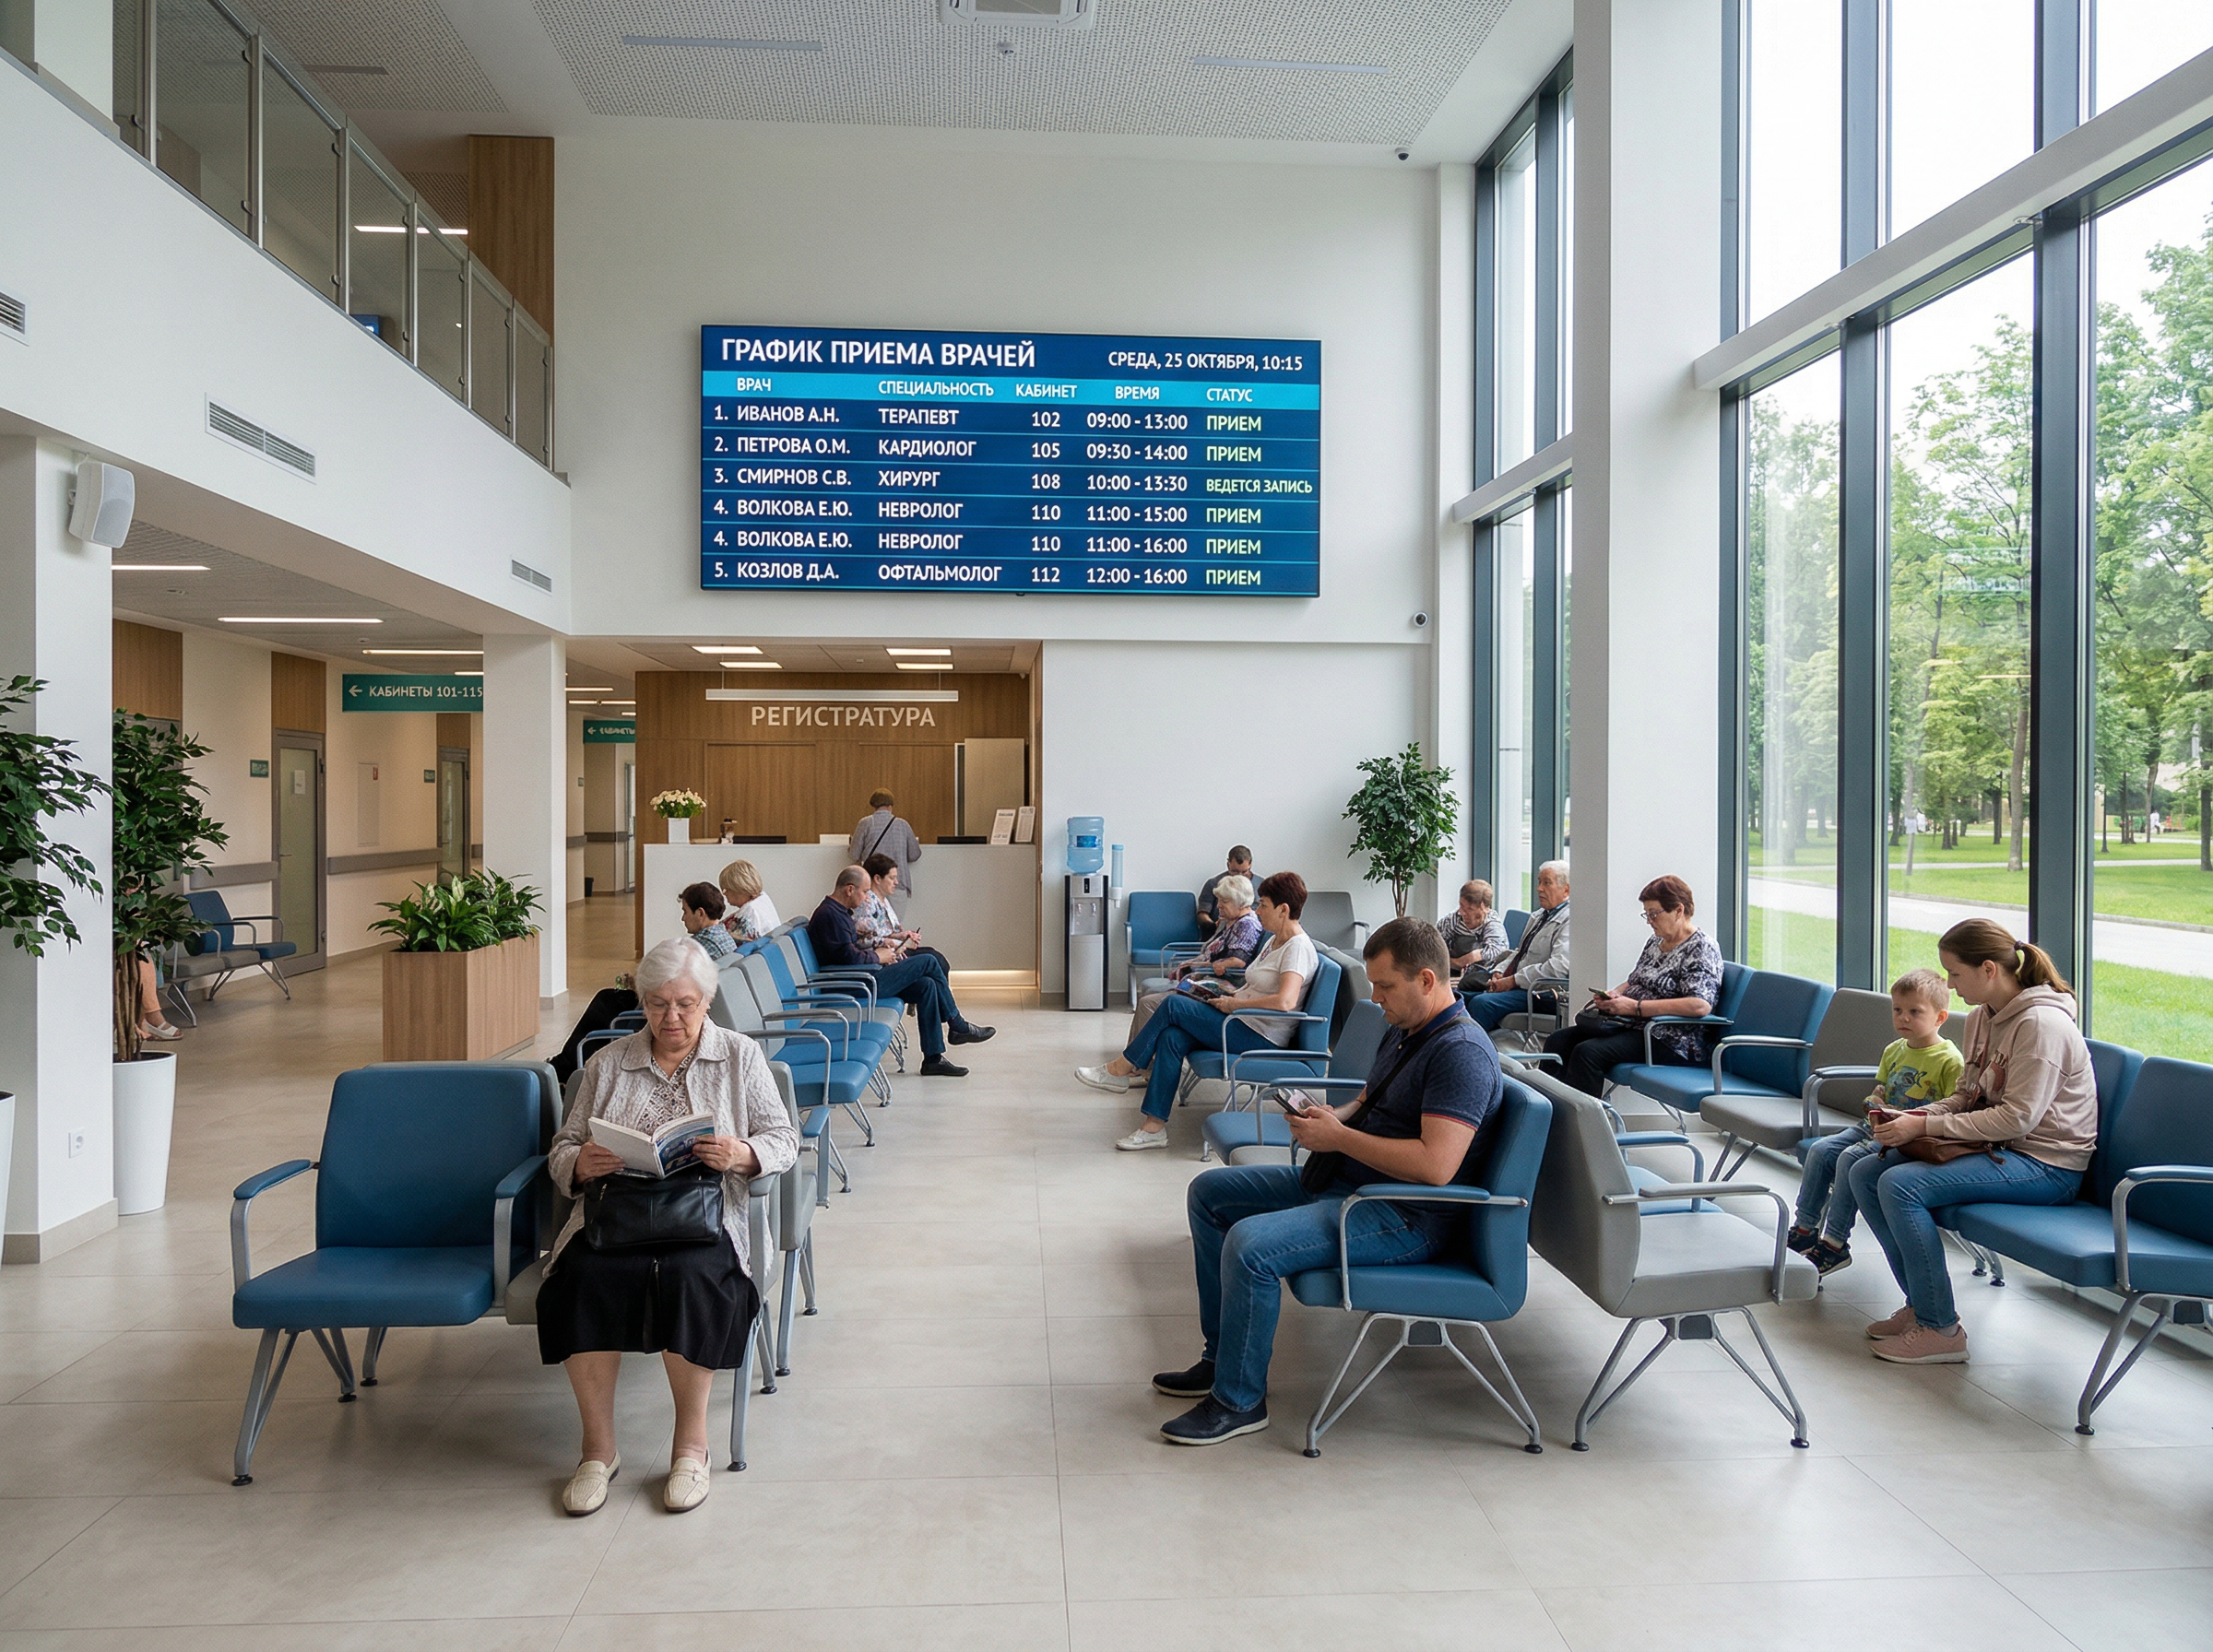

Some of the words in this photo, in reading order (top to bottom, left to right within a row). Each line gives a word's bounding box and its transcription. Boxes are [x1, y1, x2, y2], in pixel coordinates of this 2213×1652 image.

[723, 339, 822, 362] ГРАФИК
[832, 341, 934, 364] ПРИЕМА
[941, 340, 1035, 367] ВРАЧЕЙ
[1108, 352, 1161, 369] СРЕДА,
[1166, 353, 1182, 367] 25
[1187, 354, 1259, 372] ОКТЯБРЯ,
[1262, 356, 1302, 371] 10:15
[738, 378, 771, 391] ВРАЧ
[879, 381, 994, 395] СПЕЦИАЛЬНОСТЬ
[1016, 384, 1077, 397] КАБИНЕТ
[1116, 386, 1159, 399] ВРЕМЯ
[1207, 388, 1252, 402] СТАТУС
[715, 405, 728, 419] 1.
[738, 406, 804, 421] ИВАНОВ
[808, 407, 839, 422] А.Н.
[879, 408, 959, 424] ТЕРАПЕВТ
[1033, 412, 1060, 427] 102
[1087, 413, 1130, 428] 09:00
[1145, 414, 1188, 430] 13:00
[1207, 416, 1260, 431] ПРИЕМ
[715, 437, 728, 452] 2.
[738, 437, 812, 453] ПЕТРОВА
[816, 439, 850, 454] О.М.
[880, 440, 976, 457] КАРДИОЛОГ
[1032, 442, 1059, 458] 105
[1087, 443, 1130, 459] 09:30
[1145, 445, 1187, 460] 14:00
[1207, 446, 1260, 461] ПРИЕМ
[715, 468, 728, 483] 3.
[738, 468, 818, 484] СМИРНОВ
[822, 470, 851, 485] С.В.
[879, 471, 940, 487] ХИРУРГ
[1032, 474, 1060, 489] 108
[1088, 475, 1130, 490] 10:00
[1144, 476, 1187, 491] 13:30
[1207, 479, 1260, 493] ВЕДЕТСЯ
[1263, 480, 1312, 493] ЗАПИСЬ
[714, 500, 728, 514] 4.
[738, 500, 815, 515] ВОЛКОВА
[819, 502, 852, 516] Е.Ю.
[879, 502, 963, 518] НЕВРОЛОГ
[1032, 505, 1060, 520] 110
[1087, 506, 1130, 521] 11:00
[1144, 507, 1187, 522] 15:00
[1207, 508, 1260, 523] ПРИЕМ
[714, 531, 728, 546] 4.
[738, 531, 815, 547] ВОЛКОВА
[819, 533, 852, 548] Е.Ю.
[879, 534, 963, 549] НЕВРОЛОГ
[1032, 537, 1060, 551] 110
[1087, 537, 1130, 552] 11:00
[1144, 538, 1187, 553] 16:00
[1207, 539, 1260, 554] ПРИЕМ
[715, 562, 728, 577] 5.
[738, 562, 802, 578] КОЗЛОВ
[806, 563, 839, 581] Д.А.
[879, 564, 1001, 581] ОФТАЛЬМОЛОГ
[1032, 567, 1059, 582] 112
[1087, 568, 1130, 583] 12:00
[1144, 569, 1187, 584] 16:00
[1206, 570, 1260, 584] ПРИЕМ
[369, 686, 432, 697] КАБИНЕТЫ
[437, 686, 483, 698] 101-115
[751, 706, 936, 726] РЕГИСТРАТУРА
